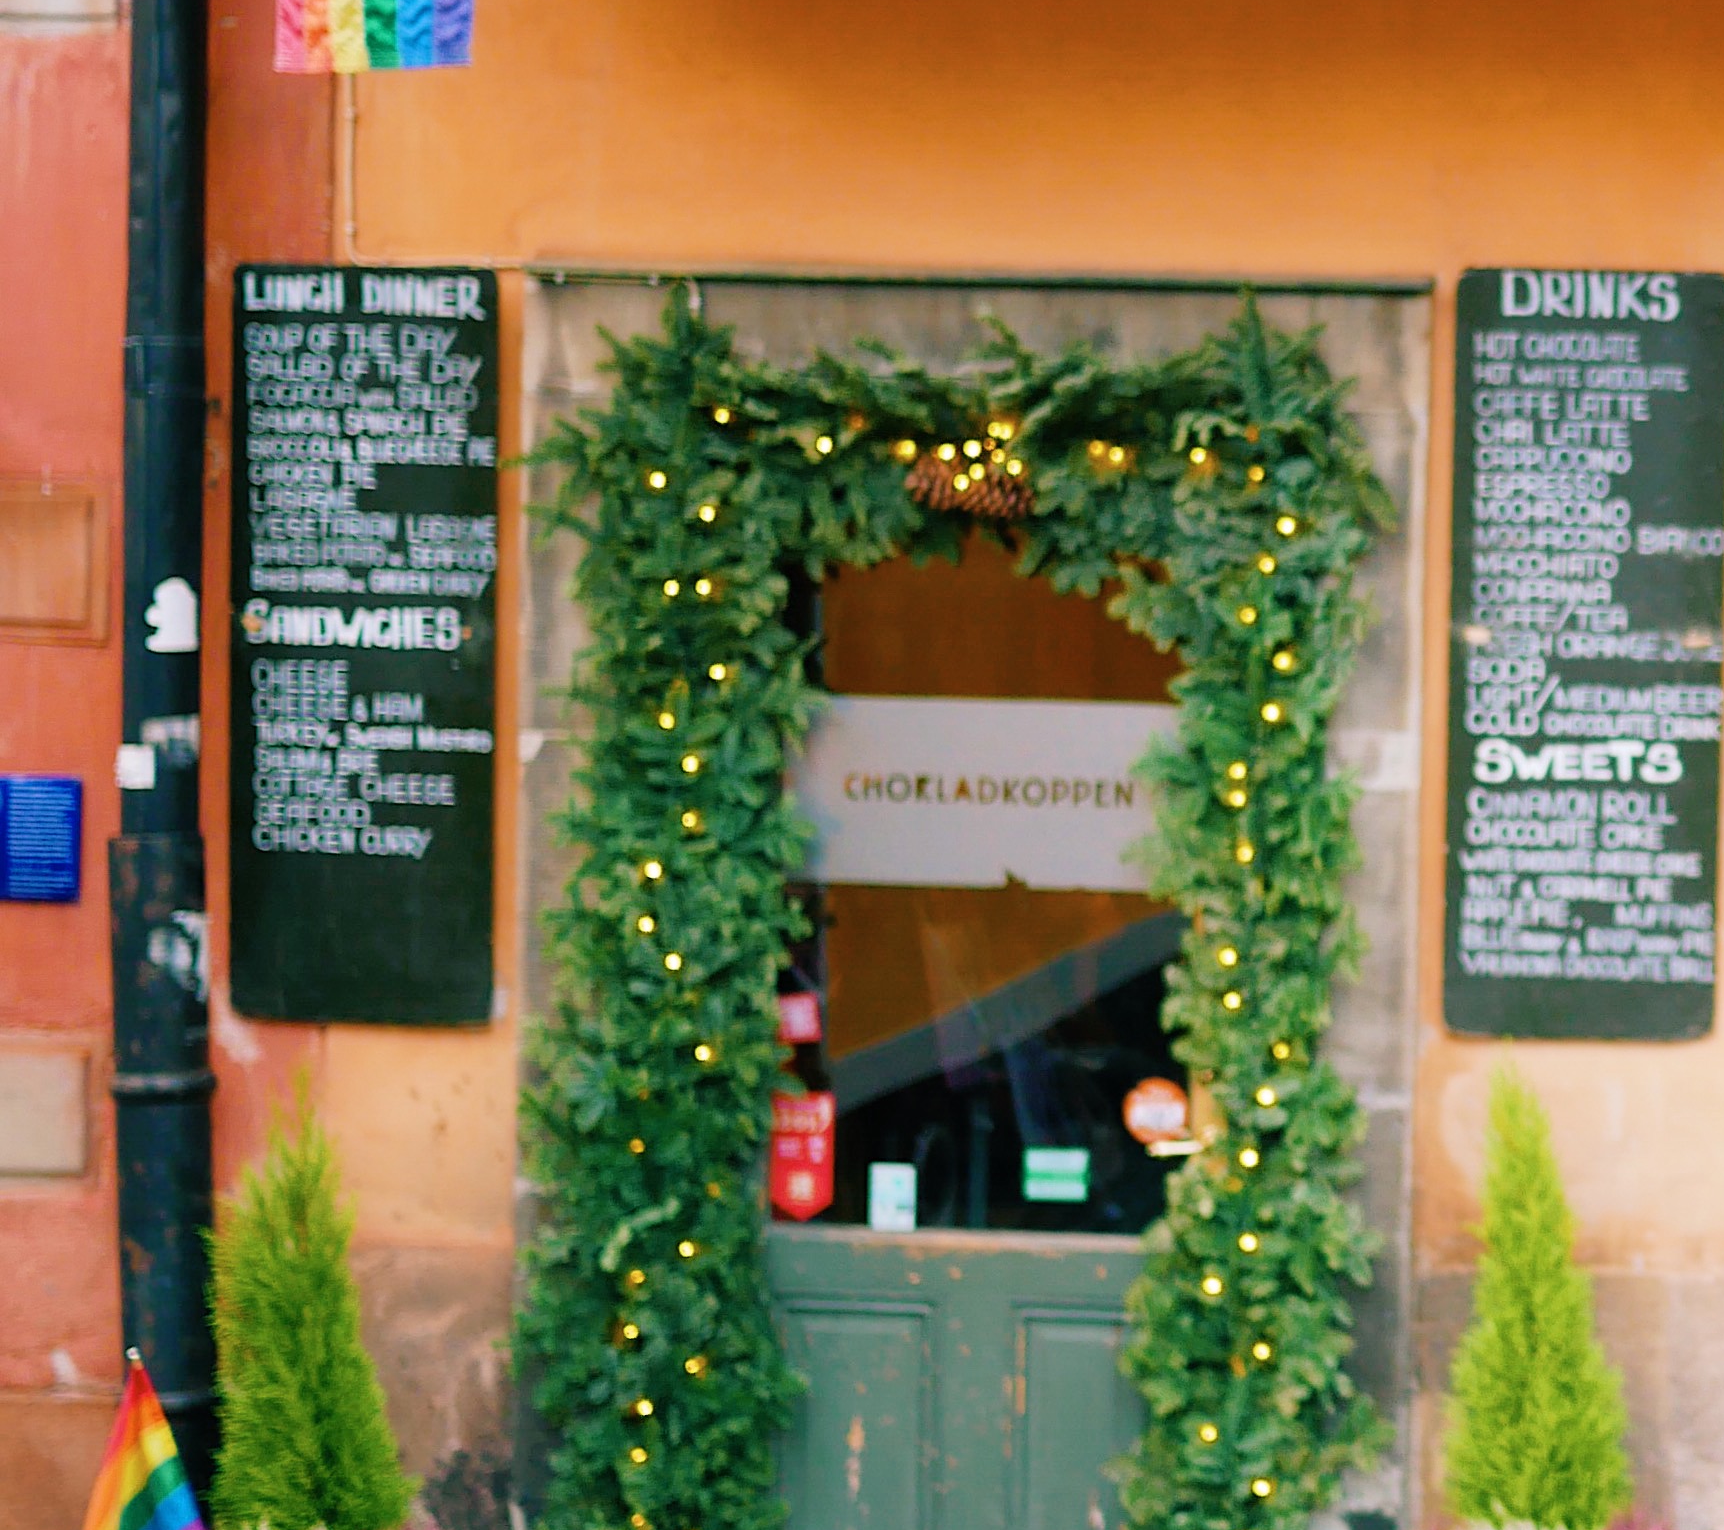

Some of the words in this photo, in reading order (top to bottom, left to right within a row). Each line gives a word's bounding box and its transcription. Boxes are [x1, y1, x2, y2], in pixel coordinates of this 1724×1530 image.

[244, 271, 345, 313] LUNCH
[361, 272, 487, 321] DINNER
[1501, 269, 1681, 322] DRINKS
[244, 322, 304, 354] SOUP
[306, 323, 340, 353] OF
[343, 323, 393, 356] THE
[399, 324, 459, 357] DAY
[1472, 331, 1520, 358] HOT
[339, 353, 369, 381] OF
[371, 353, 422, 384] THE
[429, 354, 482, 386] DAY
[1566, 391, 1650, 421] LATTE
[1543, 420, 1632, 449] LATTE
[1474, 472, 1611, 498] ESPRESSO
[244, 598, 461, 651] SANDWICHES
[251, 658, 349, 691] CHEESE
[1467, 656, 1547, 684] SODA
[251, 691, 350, 721] CHEESE
[372, 692, 424, 723] HAM
[1464, 709, 1541, 736] COLD
[359, 773, 455, 806] CHEESE
[843, 772, 1135, 808] CHOKLADKOPPEN
